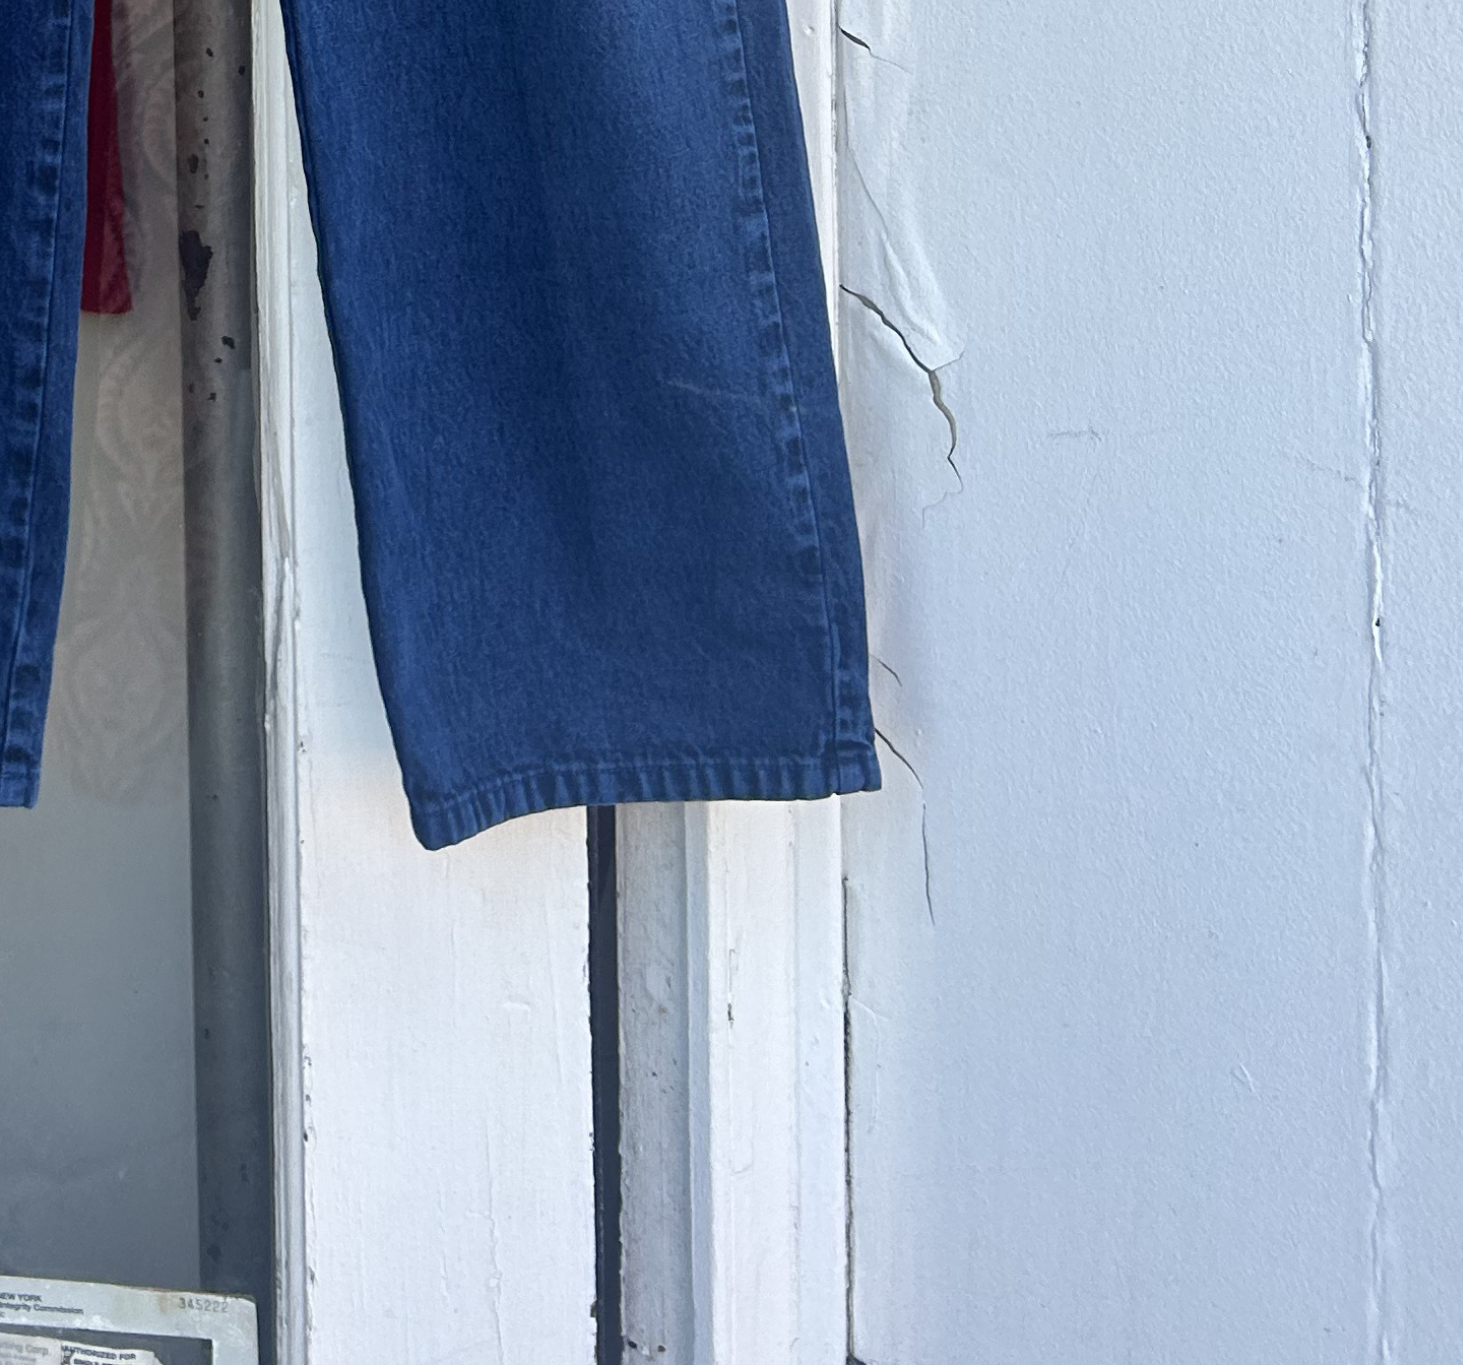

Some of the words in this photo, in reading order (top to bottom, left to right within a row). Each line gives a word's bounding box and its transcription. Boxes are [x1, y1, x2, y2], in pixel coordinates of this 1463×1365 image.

[18, 1293, 43, 1303] YORK
[0, 1301, 31, 1312] Integrity
[33, 1303, 84, 1315] Commission
[178, 1297, 230, 1314] 345222
